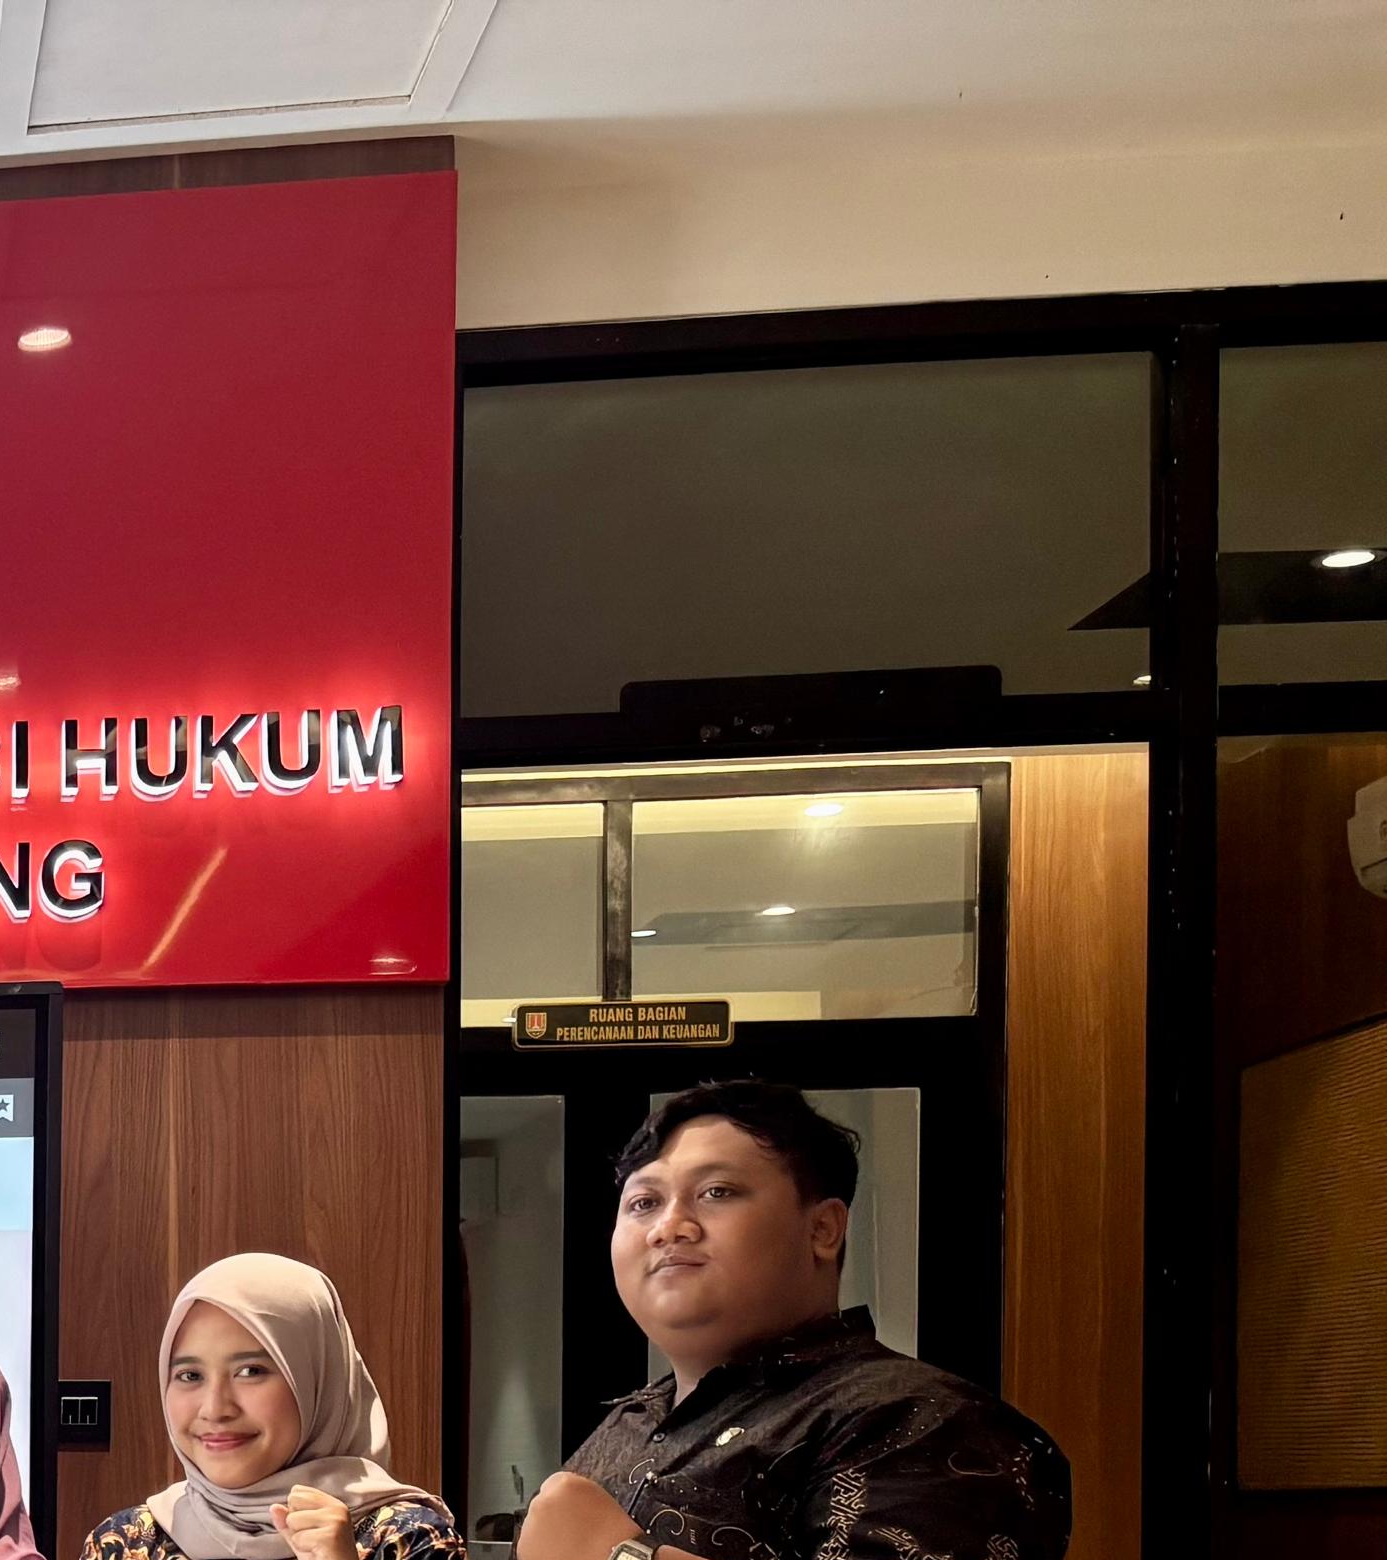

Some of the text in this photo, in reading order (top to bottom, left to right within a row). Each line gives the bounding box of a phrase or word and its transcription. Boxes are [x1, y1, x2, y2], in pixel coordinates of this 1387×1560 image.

[60, 704, 404, 798] HUKUM
[589, 1006, 687, 1023] RUANG BAGIAN
[556, 1023, 720, 1041] PERENCANAAN DAN KEUANGAN
